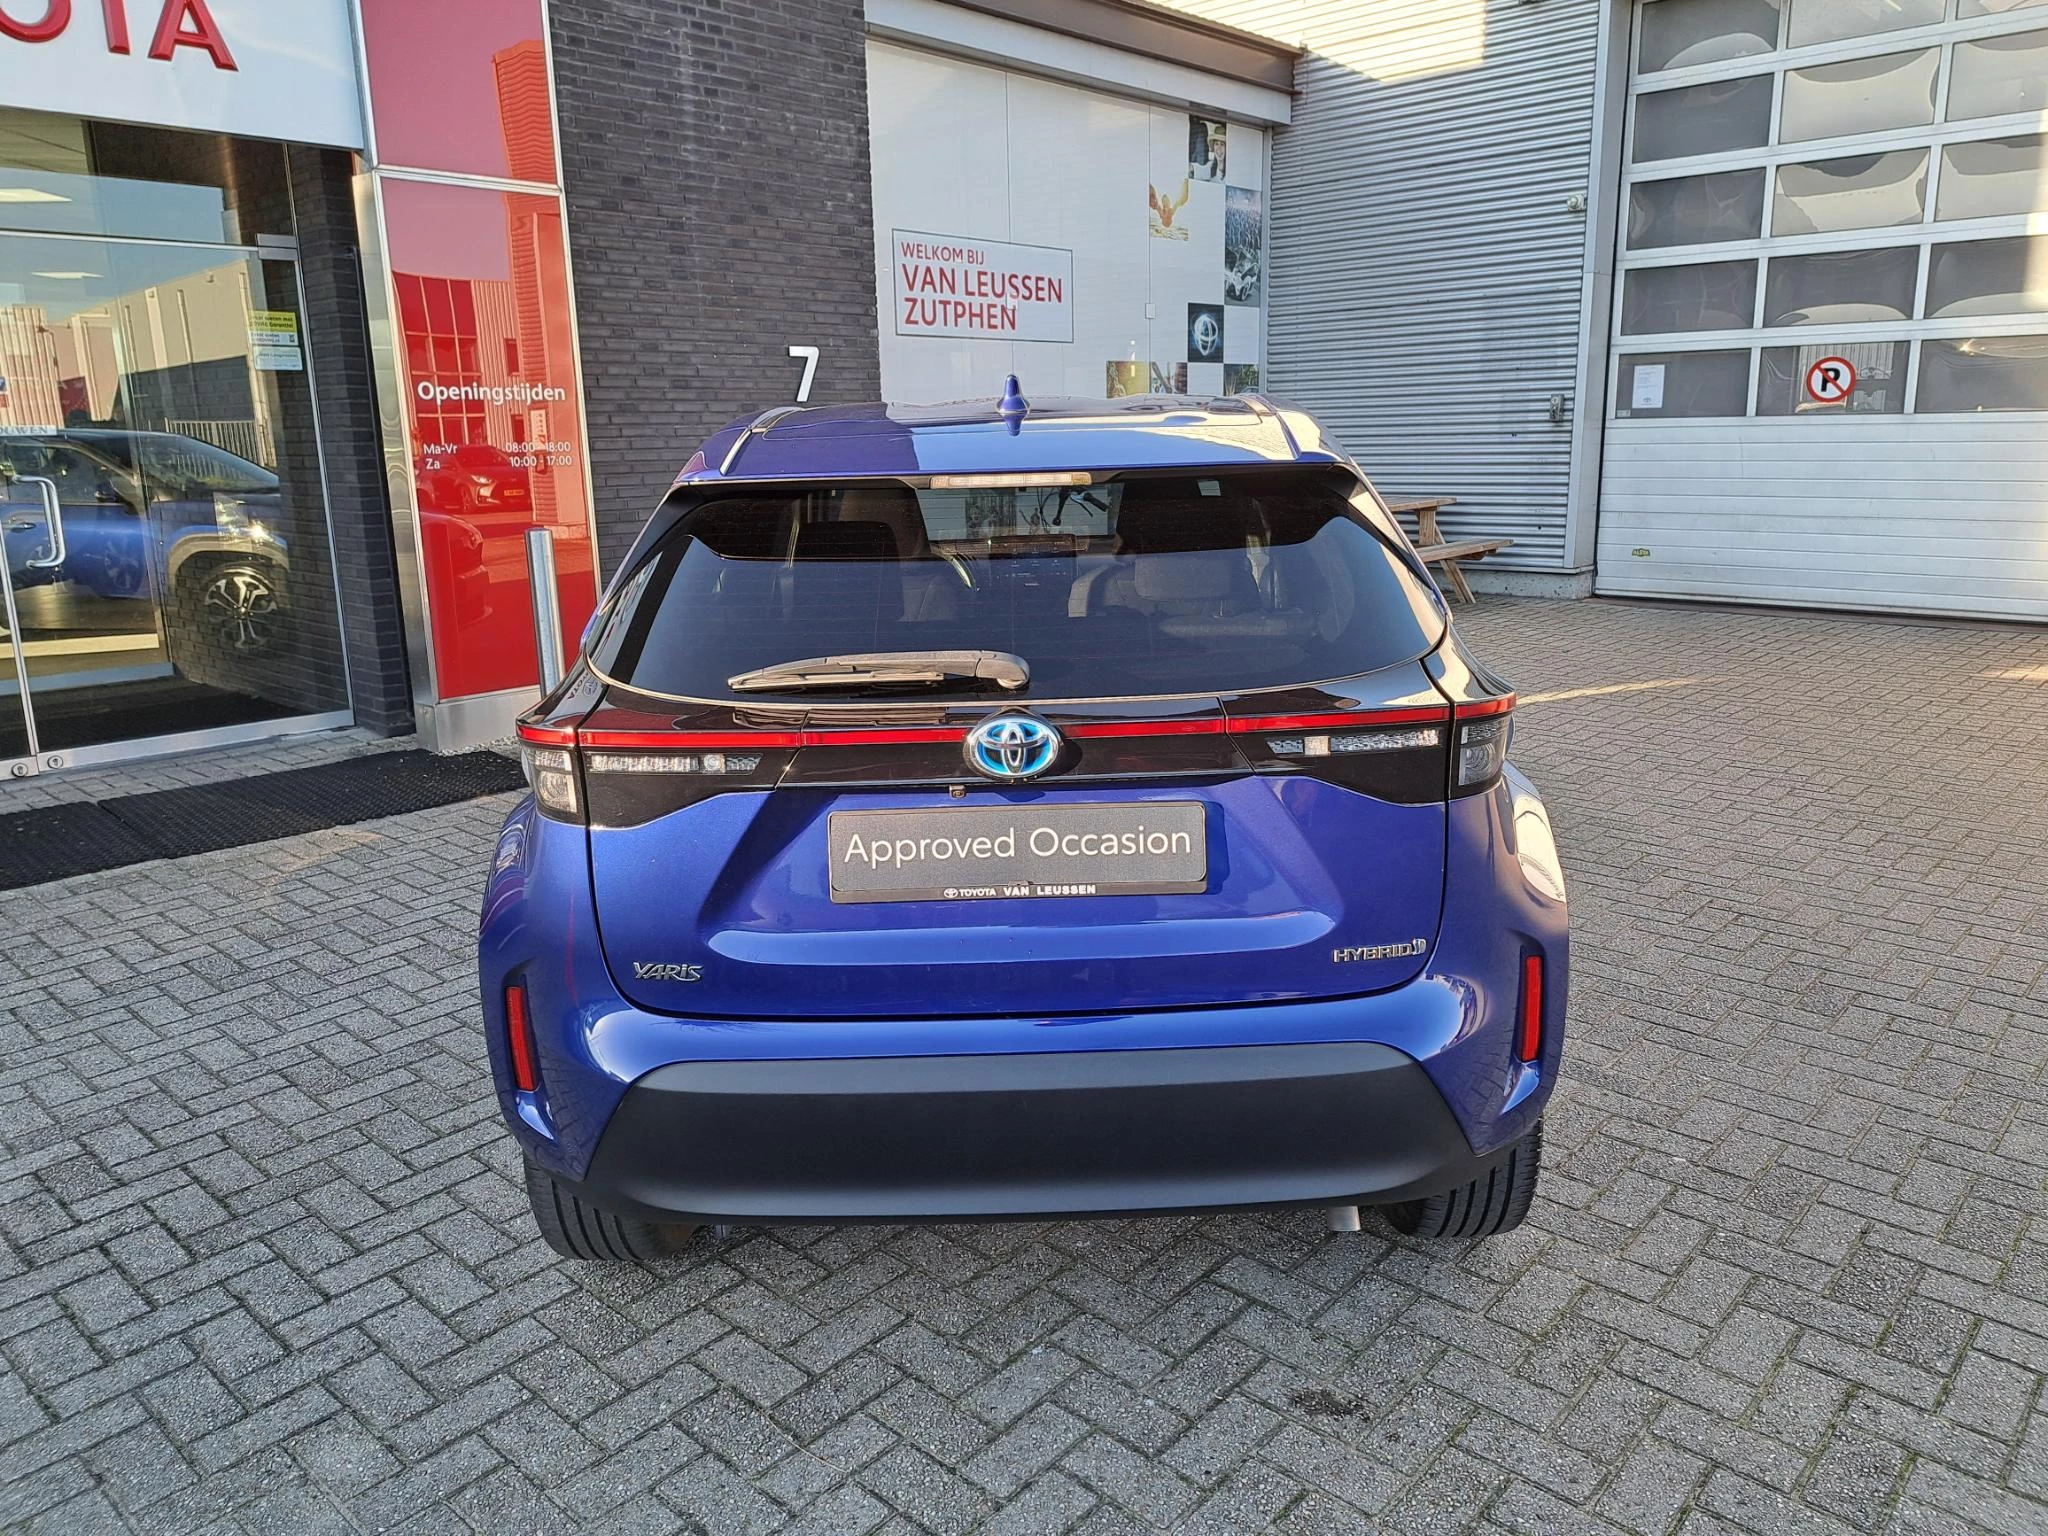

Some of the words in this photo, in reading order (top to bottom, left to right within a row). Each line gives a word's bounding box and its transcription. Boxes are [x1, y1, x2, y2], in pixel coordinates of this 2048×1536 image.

[901, 242, 963, 262] WELKOM
[966, 250, 985, 265] BIJ
[901, 263, 956, 295] VAN
[964, 269, 1063, 303] LEUSSEN
[904, 297, 1016, 329] ZUTPHEN
[788, 346, 819, 402] 7
[417, 381, 565, 405] Openingstijden
[423, 443, 458, 455] Ma-Vr
[505, 441, 536, 453] 08:00
[545, 441, 571, 452] 18:00
[425, 458, 441, 470] Za
[509, 456, 537, 468] 10:00
[546, 455, 572, 466] 17:00
[844, 827, 1016, 869] Approved
[1029, 825, 1192, 857] Occasion
[959, 888, 997, 897] TOYOTA
[1003, 887, 1030, 896] VAN
[1036, 884, 1097, 895] LEUSSEN
[1333, 943, 1414, 963] HYBRID
